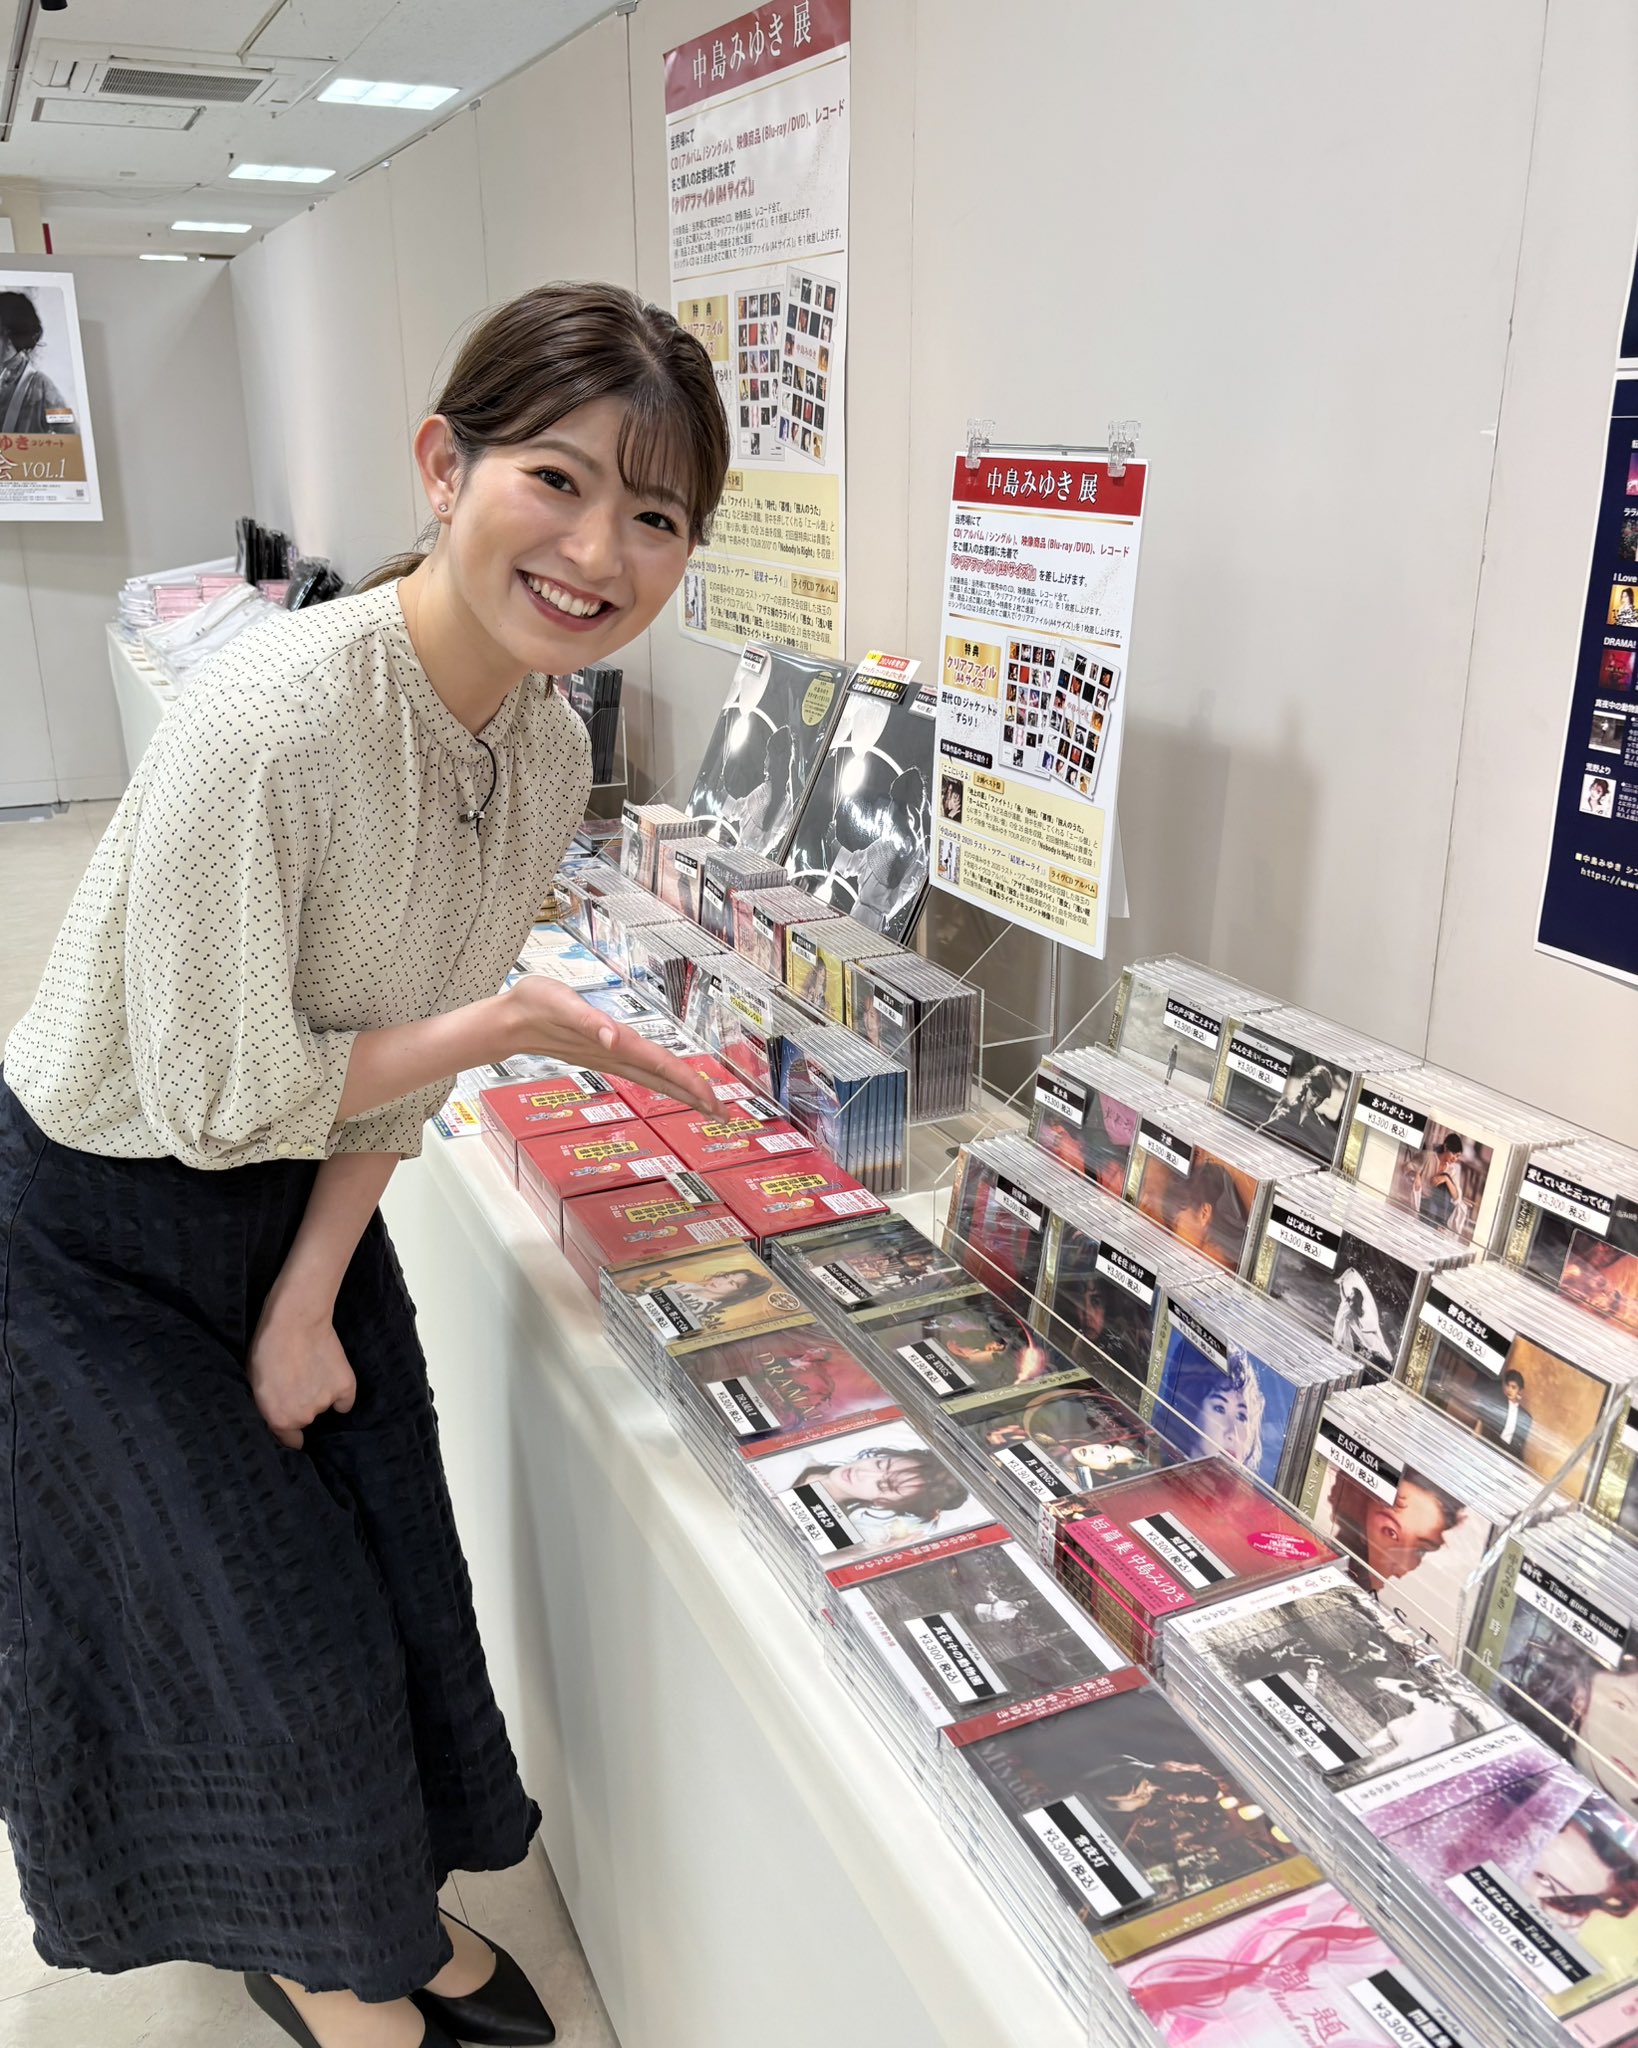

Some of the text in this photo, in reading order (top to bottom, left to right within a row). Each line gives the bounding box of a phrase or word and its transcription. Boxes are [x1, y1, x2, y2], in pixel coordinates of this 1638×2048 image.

[693, 12, 784, 88] 中島みゆき
[32, 439, 65, 447] コンサート
[22, 458, 66, 479] VOL.1
[987, 467, 1098, 504] 中島みゆき 展
[1618, 573, 1638, 582] Love
[1603, 637, 1637, 649] DRAMA!
[1285, 1215, 1323, 1241] はじめまして
[1337, 1433, 1379, 1472] EAST ASIA
[809, 1503, 835, 1529] 荒野より
[931, 1625, 984, 1686] 真夜中の動物園
[1290, 1702, 1329, 1734] 心守歌
[1071, 1833, 1108, 1869] 常夜灯
